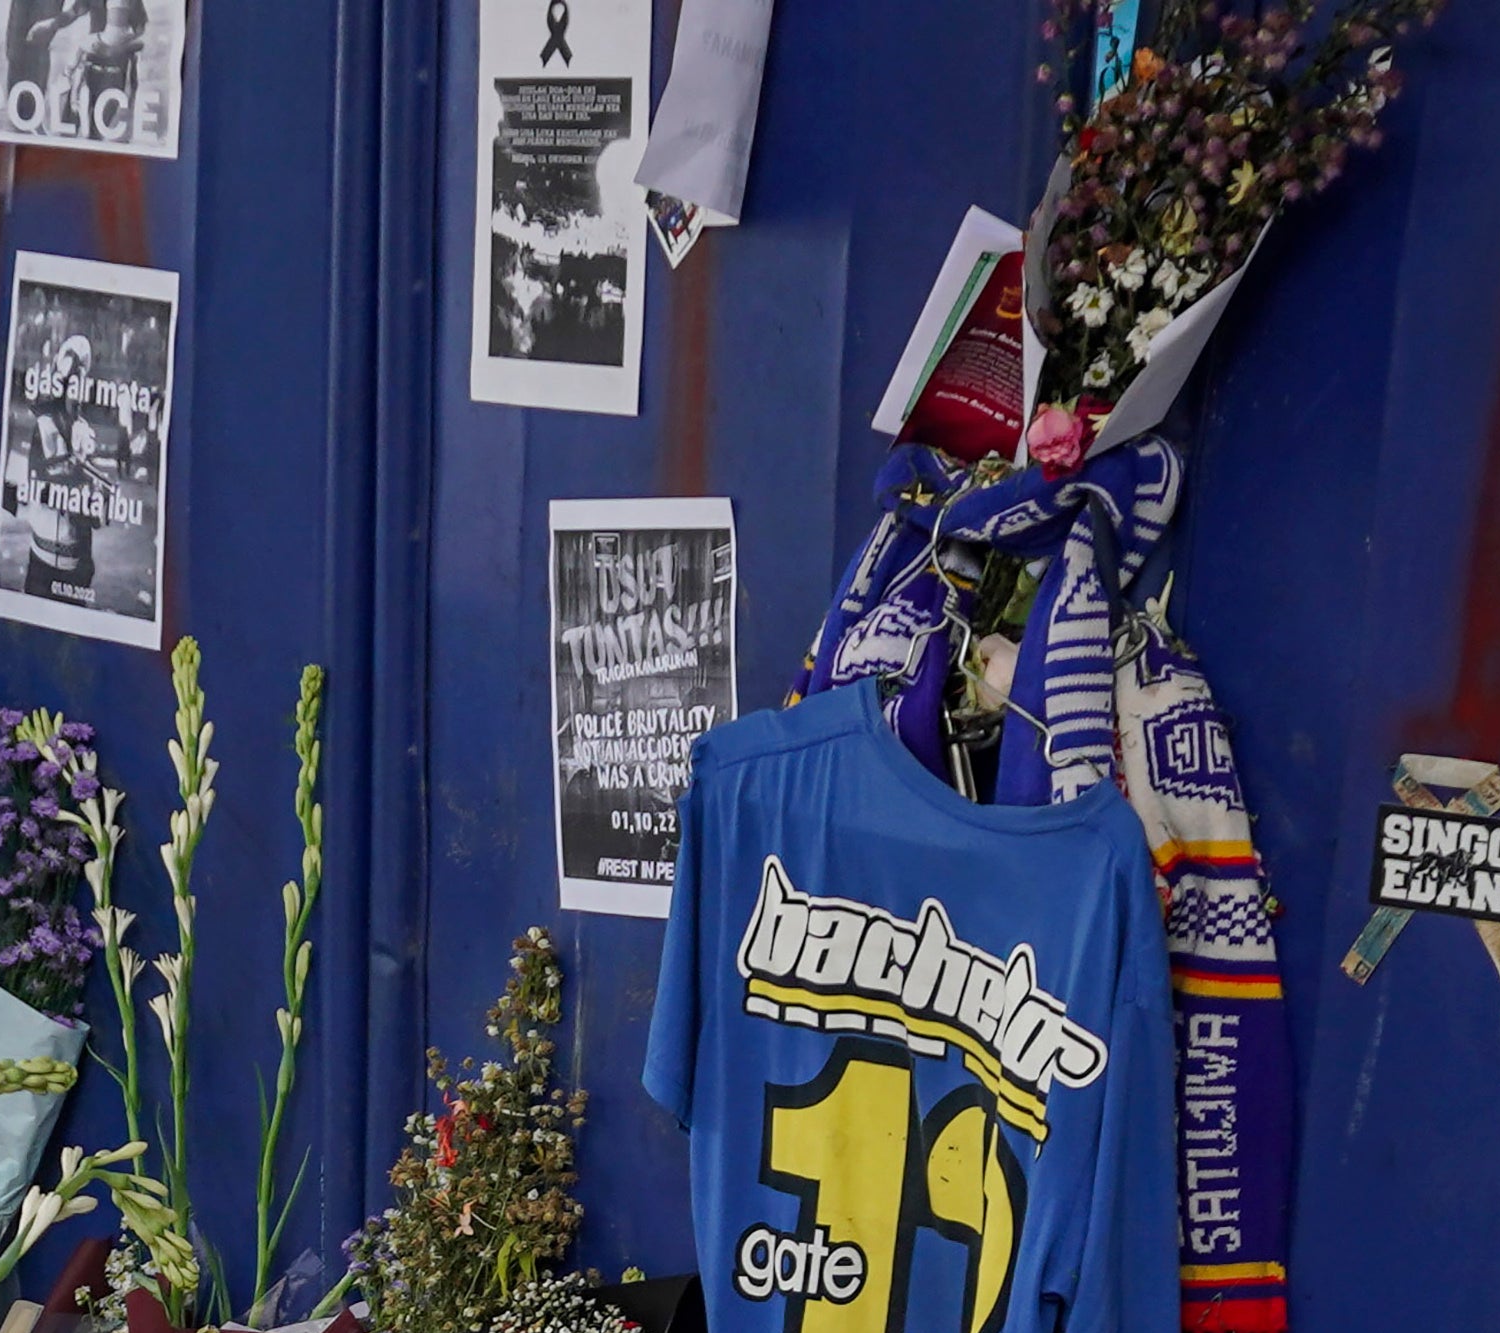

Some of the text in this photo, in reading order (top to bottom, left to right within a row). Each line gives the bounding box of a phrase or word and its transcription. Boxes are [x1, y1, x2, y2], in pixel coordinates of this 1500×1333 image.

[24, 365, 151, 413] gas air mata
[16, 470, 143, 526] air mata ibu
[574, 704, 716, 738] POLICE BRUTALITY
[597, 764, 629, 789] WAS
[633, 765, 645, 787] A
[641, 859, 655, 880] IN
[737, 1226, 866, 1302] gate
